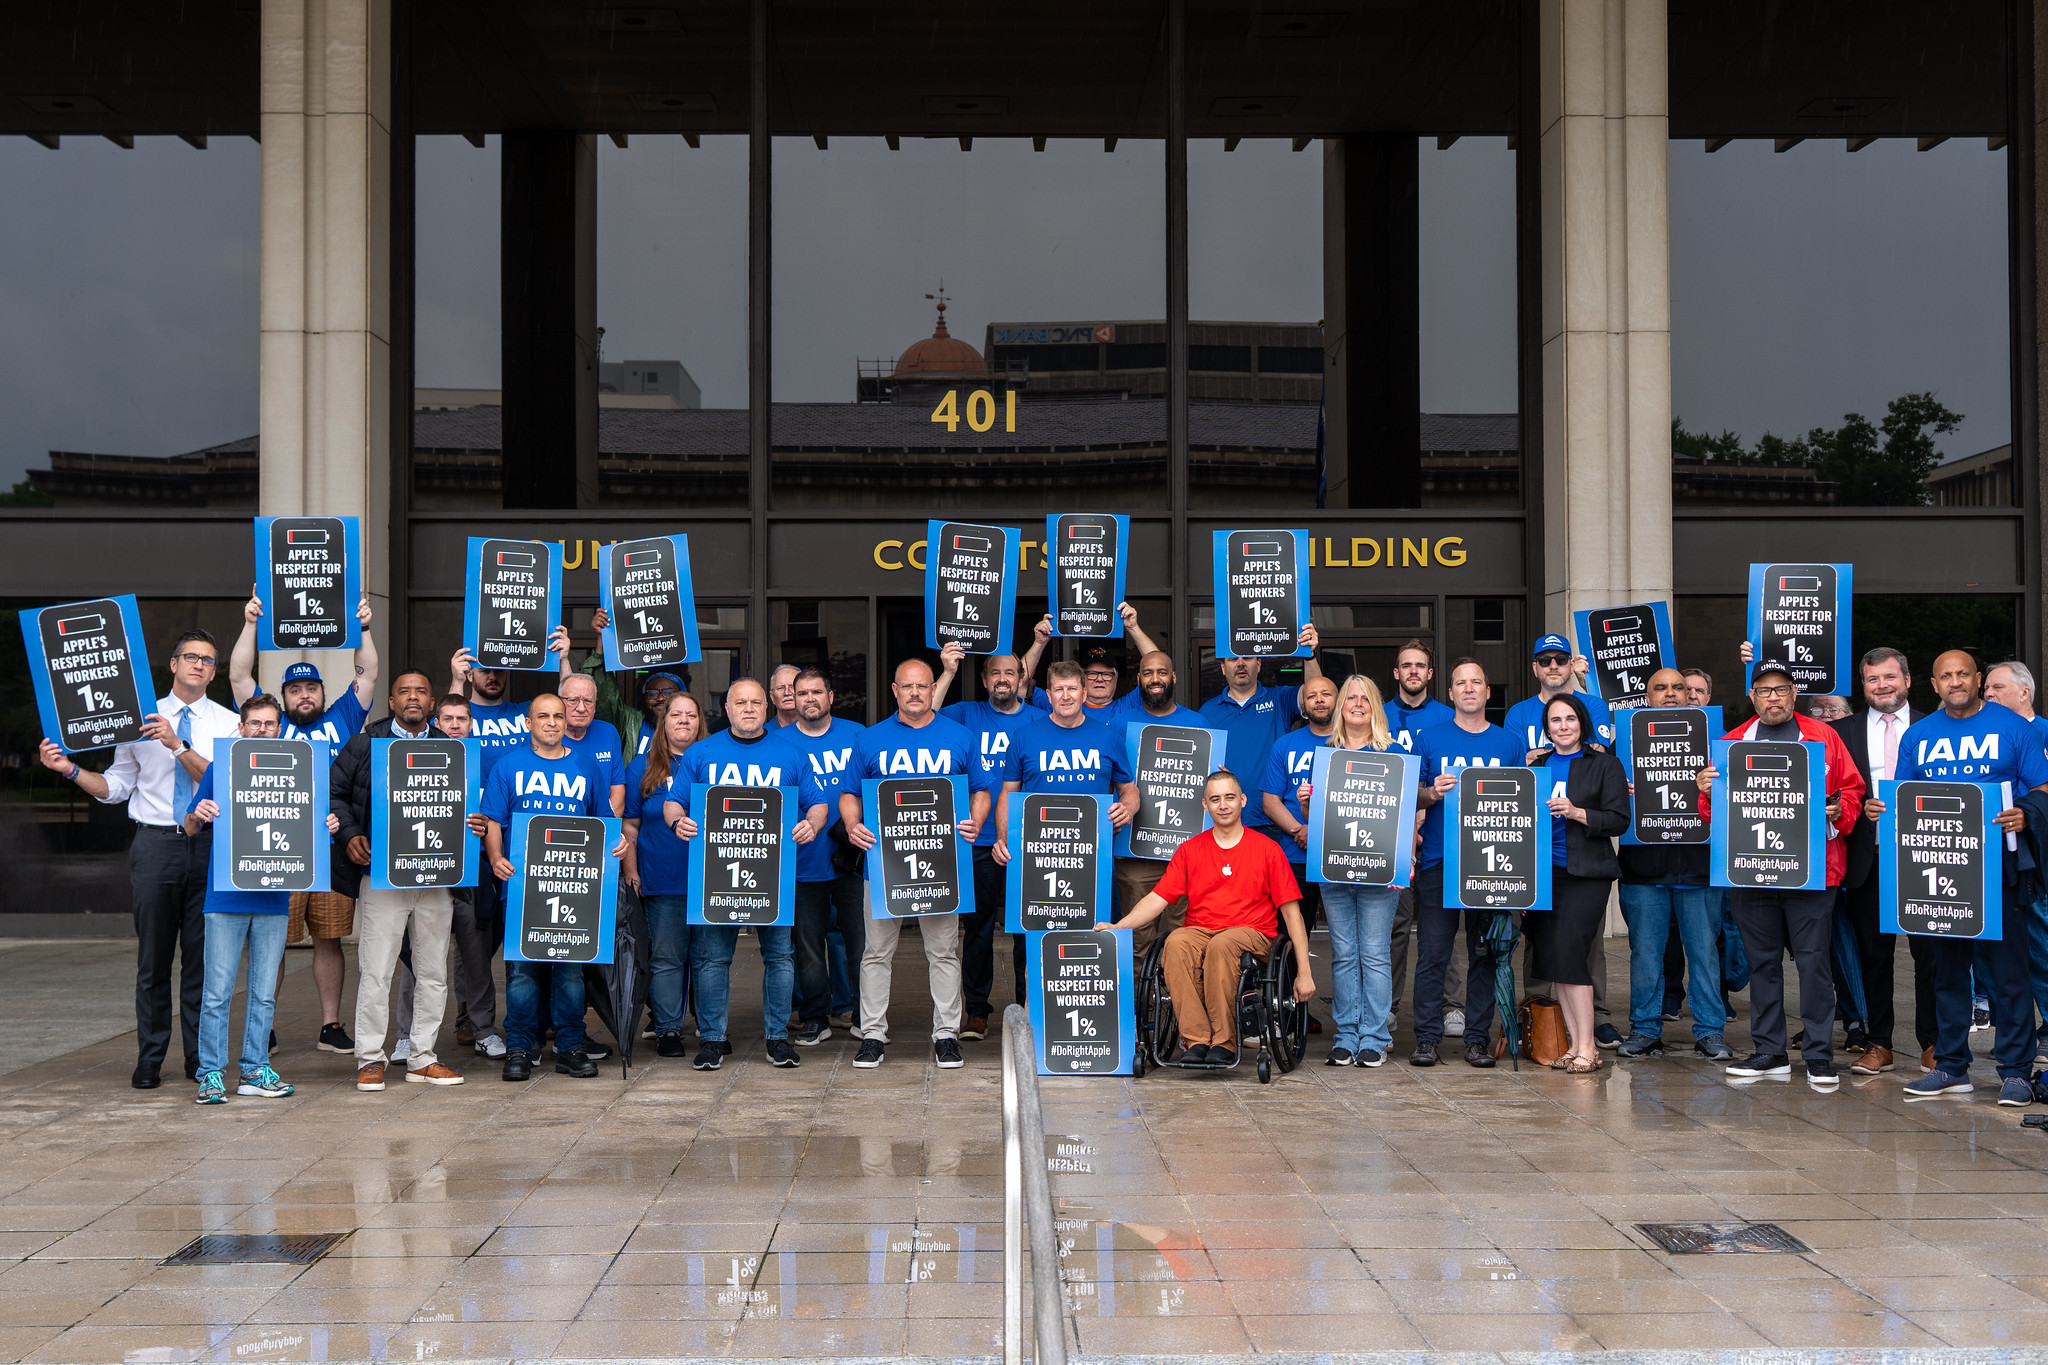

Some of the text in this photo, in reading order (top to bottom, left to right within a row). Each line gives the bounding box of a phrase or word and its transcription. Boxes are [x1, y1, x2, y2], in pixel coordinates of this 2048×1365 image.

[931, 390, 1016, 432] 401
[1309, 536, 1467, 567] ILDING
[1058, 556, 1113, 566] RESPECT FOR
[275, 563, 341, 574] RESPECT FOR
[940, 566, 999, 582] RESPECT FOR
[1064, 568, 1106, 579] WORKERS
[284, 577, 332, 588] WORKERS
[1232, 574, 1292, 585] RESPECT FOR
[484, 583, 544, 597] RESPECT FOR
[615, 580, 674, 596] RESPECT FOR
[947, 581, 990, 595] WORKERS
[1071, 581, 1097, 604] 1%
[1240, 587, 1285, 598] WORKERS
[294, 591, 324, 615] 1%
[492, 597, 536, 610] WORKERS
[623, 594, 668, 609] WORKERS
[953, 595, 979, 621] 1%
[1060, 611, 1107, 622] #DoRightApple
[1249, 600, 1276, 624] 1%
[1766, 610, 1832, 621] RESPECT FOR
[279, 623, 337, 634] #DoRightApple
[499, 611, 526, 636] 1%
[633, 610, 663, 634] 1%
[939, 625, 990, 640] #DoRightApple
[1235, 631, 1289, 642] #DoRightApple
[1774, 624, 1823, 635] WORKERS
[483, 642, 537, 655] #DoRightApple
[623, 638, 677, 653] #DoRightApple
[1596, 643, 1656, 659] RESPECT FOR
[1783, 637, 1813, 662] 1%
[51, 648, 125, 670] RESPECT FOR
[1606, 656, 1650, 670] WORKERS
[293, 666, 311, 674] IAM
[1761, 663, 1785, 671] UNION
[63, 665, 118, 684] WORKERS
[1616, 670, 1645, 692] 1%
[77, 684, 114, 711] 1%
[1256, 700, 1274, 711] IAM
[67, 715, 133, 734] #DoRightApple
[472, 714, 530, 737] IAM
[981, 732, 1010, 754] IA
[1918, 734, 1999, 766] IAM
[596, 751, 611, 760] IAM
[879, 748, 950, 775] IAM
[1040, 748, 1100, 771] IAM
[1288, 751, 1314, 774] IA
[1637, 755, 1704, 767] RESPECT FOR
[709, 763, 781, 786] IAM
[1047, 773, 1095, 783] UNION
[1140, 770, 1204, 786] RESPECT FOR
[1646, 770, 1696, 781] WORKERS
[1925, 765, 1990, 777] UNION
[516, 771, 586, 801] IAM
[1148, 784, 1194, 799] WORKERS
[236, 790, 309, 804] RESPECT FOR
[393, 790, 461, 802] RESPECT FOR
[1329, 791, 1397, 806] RESPECT FOR
[1655, 784, 1686, 809] 1%
[1733, 791, 1804, 804] RESPECT FOR
[246, 806, 300, 819] WORKERS
[403, 805, 452, 818] WORKERS
[523, 800, 576, 812] UNION
[1154, 800, 1182, 826] 1%
[1337, 805, 1386, 819] WORKERS
[1742, 806, 1794, 819] WORKERS
[1464, 815, 1531, 827] RESPECT FOR
[1641, 817, 1701, 828] #DoRightApple
[256, 822, 289, 851] 1%
[412, 821, 442, 848] 1%
[884, 824, 951, 837] RESPECT FOR
[1345, 821, 1374, 847] 1%
[1472, 830, 1522, 842] WORKERS
[1751, 822, 1784, 849] 1%
[709, 832, 776, 844] RESPECT FOR
[894, 838, 943, 850] WORKERS
[1902, 834, 1978, 849] RESPECT FOR
[718, 846, 767, 858] WORKERS
[1027, 842, 1092, 854] RESPECT FOR
[395, 857, 455, 870] #DoRightApple
[1035, 856, 1084, 868] WORKERS
[1328, 854, 1386, 868] #DoRightApple
[1481, 845, 1512, 872] 1%
[1734, 857, 1798, 871] #DoRightApple
[1912, 850, 1968, 865] WORKERS
[239, 860, 304, 873] #DoRightApple
[530, 865, 598, 879] RESPECT FOR
[904, 853, 935, 879] 1%
[726, 861, 756, 888] 1%
[1922, 867, 1957, 896] 1%
[538, 880, 588, 894] WORKERS
[1044, 871, 1073, 898] 1%
[1466, 880, 1526, 892] #DoRightApple
[891, 885, 949, 899] #DoRightApple
[709, 896, 770, 908] #DoRightApple
[546, 896, 576, 924] 1%
[1027, 905, 1086, 918] #DoRightApple
[1905, 903, 1973, 919] #DoRightApple
[527, 931, 589, 945] #DoRightApple
[1047, 979, 1113, 991] RESPECT FOR
[1056, 994, 1105, 1006] WORKERS
[1066, 1009, 1096, 1036] 1%
[1051, 1045, 1110, 1057] #DoRightApple
